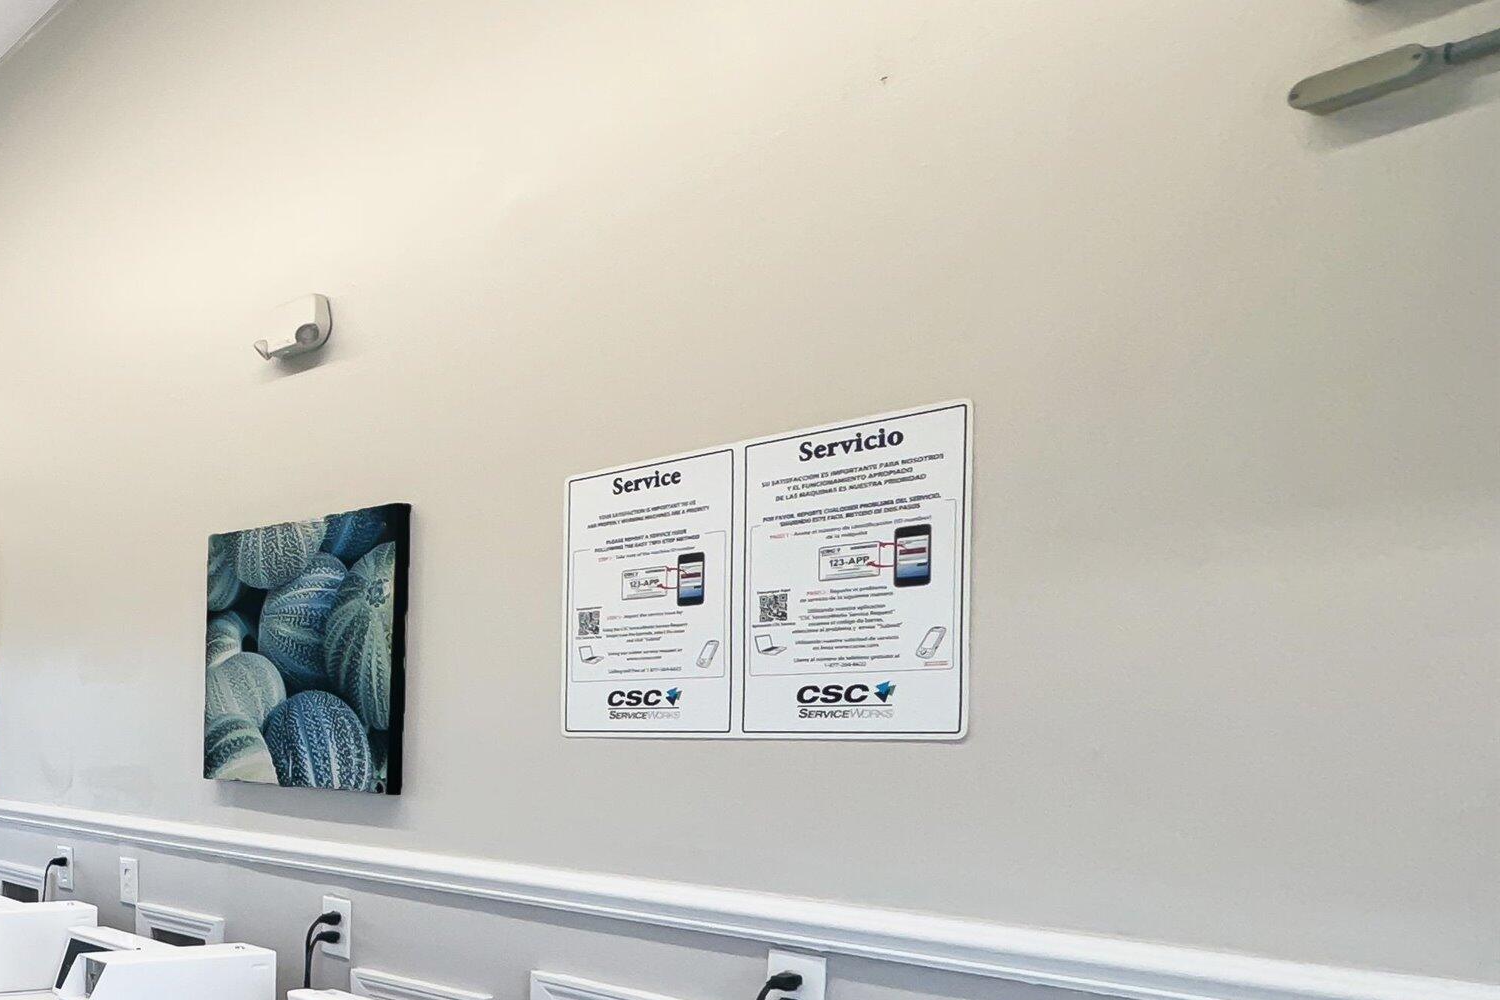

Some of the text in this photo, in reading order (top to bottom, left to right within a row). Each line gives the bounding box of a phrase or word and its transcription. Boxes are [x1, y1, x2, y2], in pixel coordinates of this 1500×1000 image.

[799, 428, 904, 462] Servicio
[612, 470, 682, 495] Service
[829, 556, 870, 567] 123-APP
[608, 689, 662, 707] CSC
[796, 684, 869, 704] CSC
